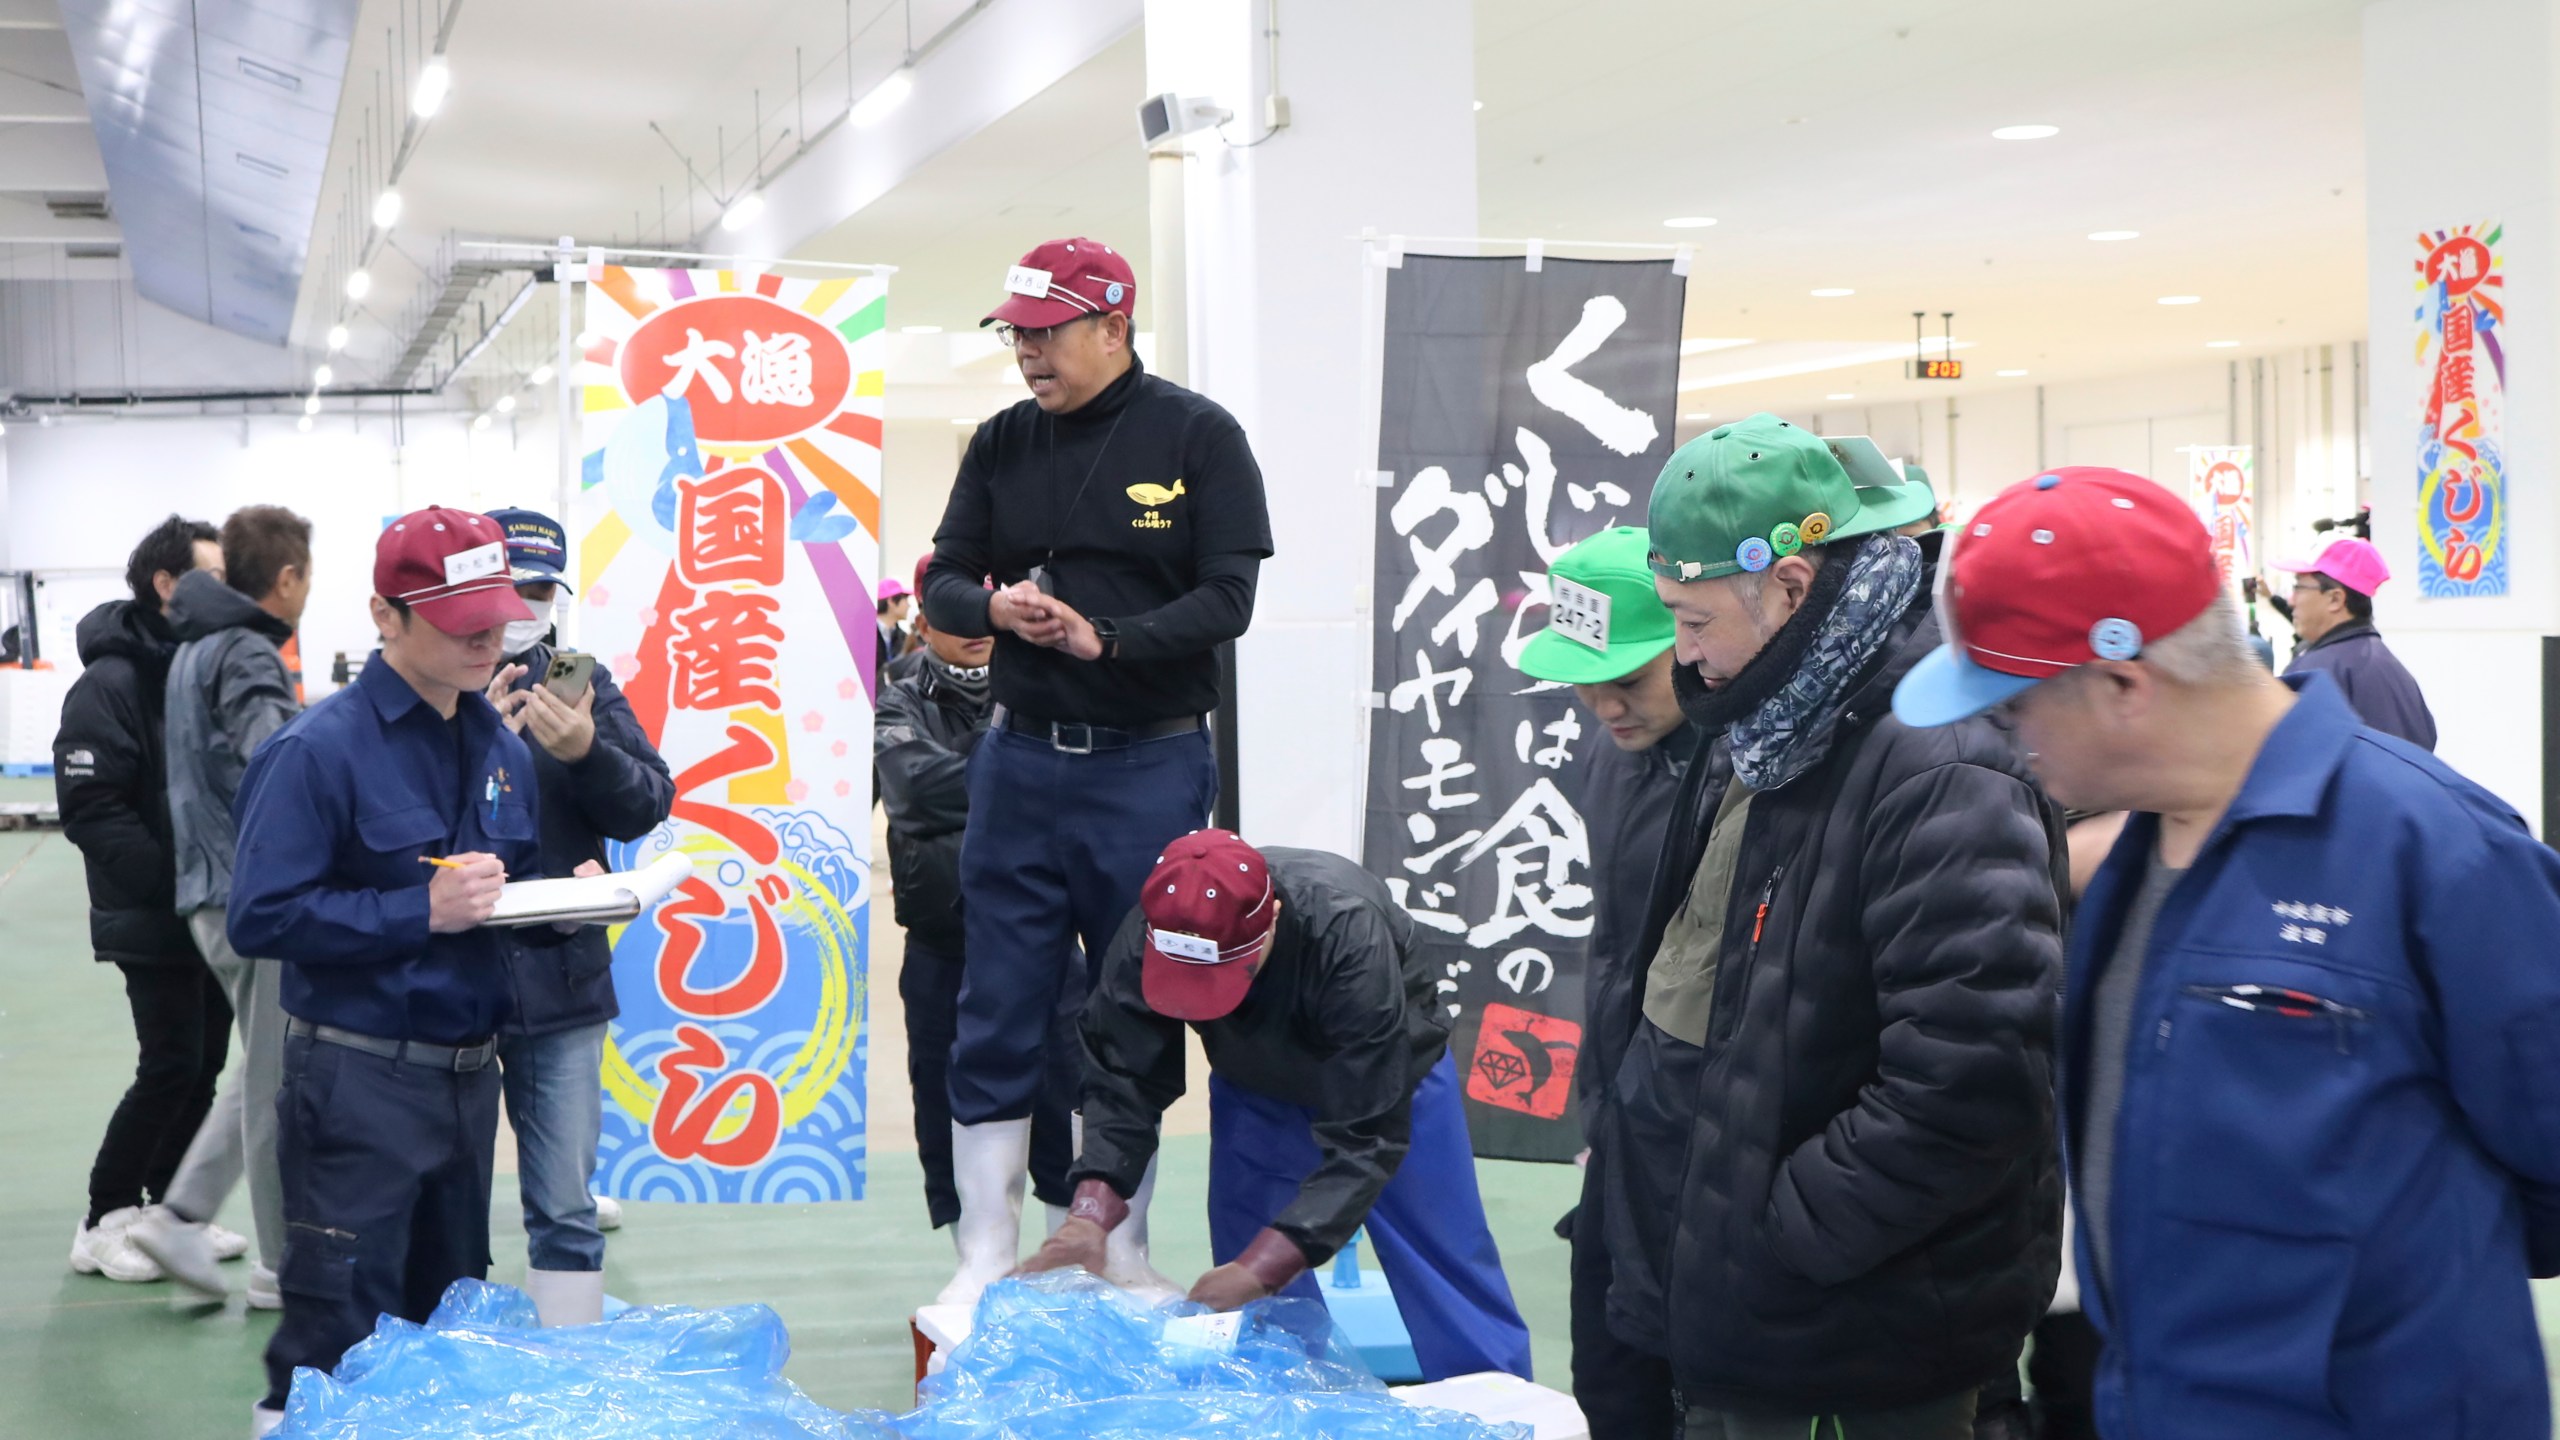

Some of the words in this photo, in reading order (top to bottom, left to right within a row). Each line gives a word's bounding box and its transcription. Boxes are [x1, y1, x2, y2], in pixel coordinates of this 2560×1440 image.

[662, 327, 816, 407] 大漁
[2441, 303, 2483, 582] 国産くじら
[1554, 603, 1603, 640] 247-2
[652, 466, 791, 1168] 国産くじら
